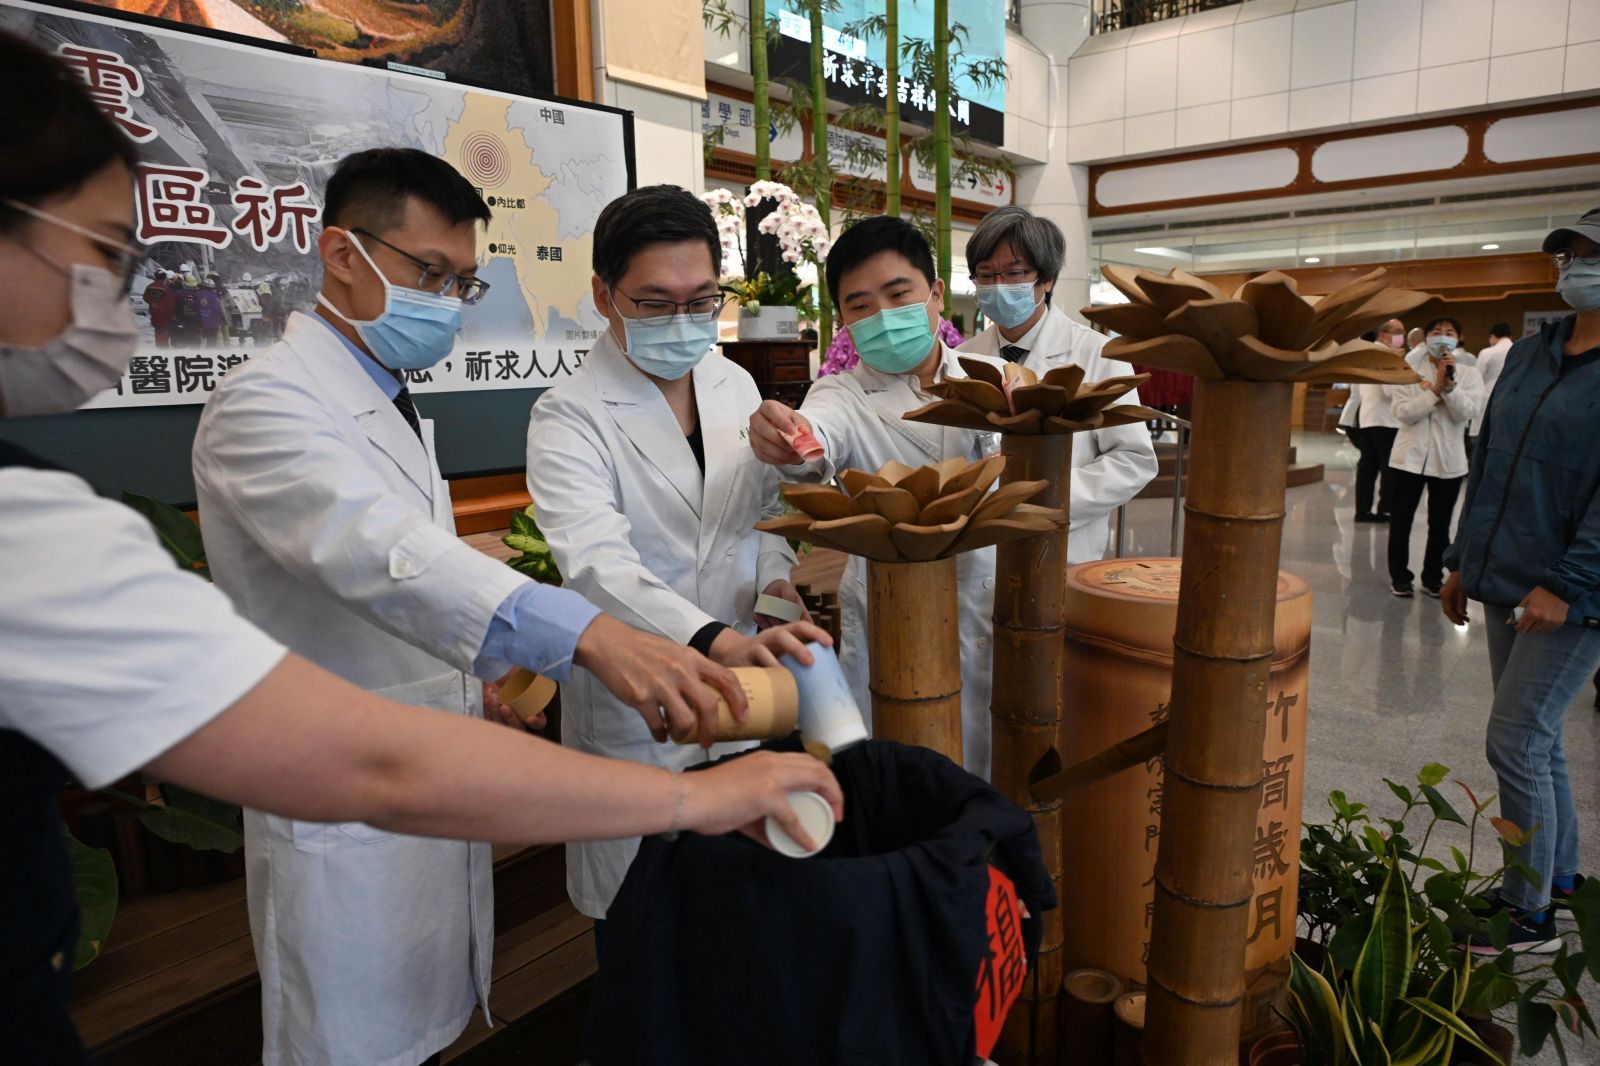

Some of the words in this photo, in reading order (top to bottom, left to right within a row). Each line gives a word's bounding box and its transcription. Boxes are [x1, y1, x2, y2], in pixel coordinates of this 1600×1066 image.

[539, 107, 565, 125] 中國
[496, 196, 526, 209] 內比都
[497, 243, 517, 255] 仰光
[536, 246, 562, 262] 泰國
[1247, 690, 1299, 944] 竹筒歲月
